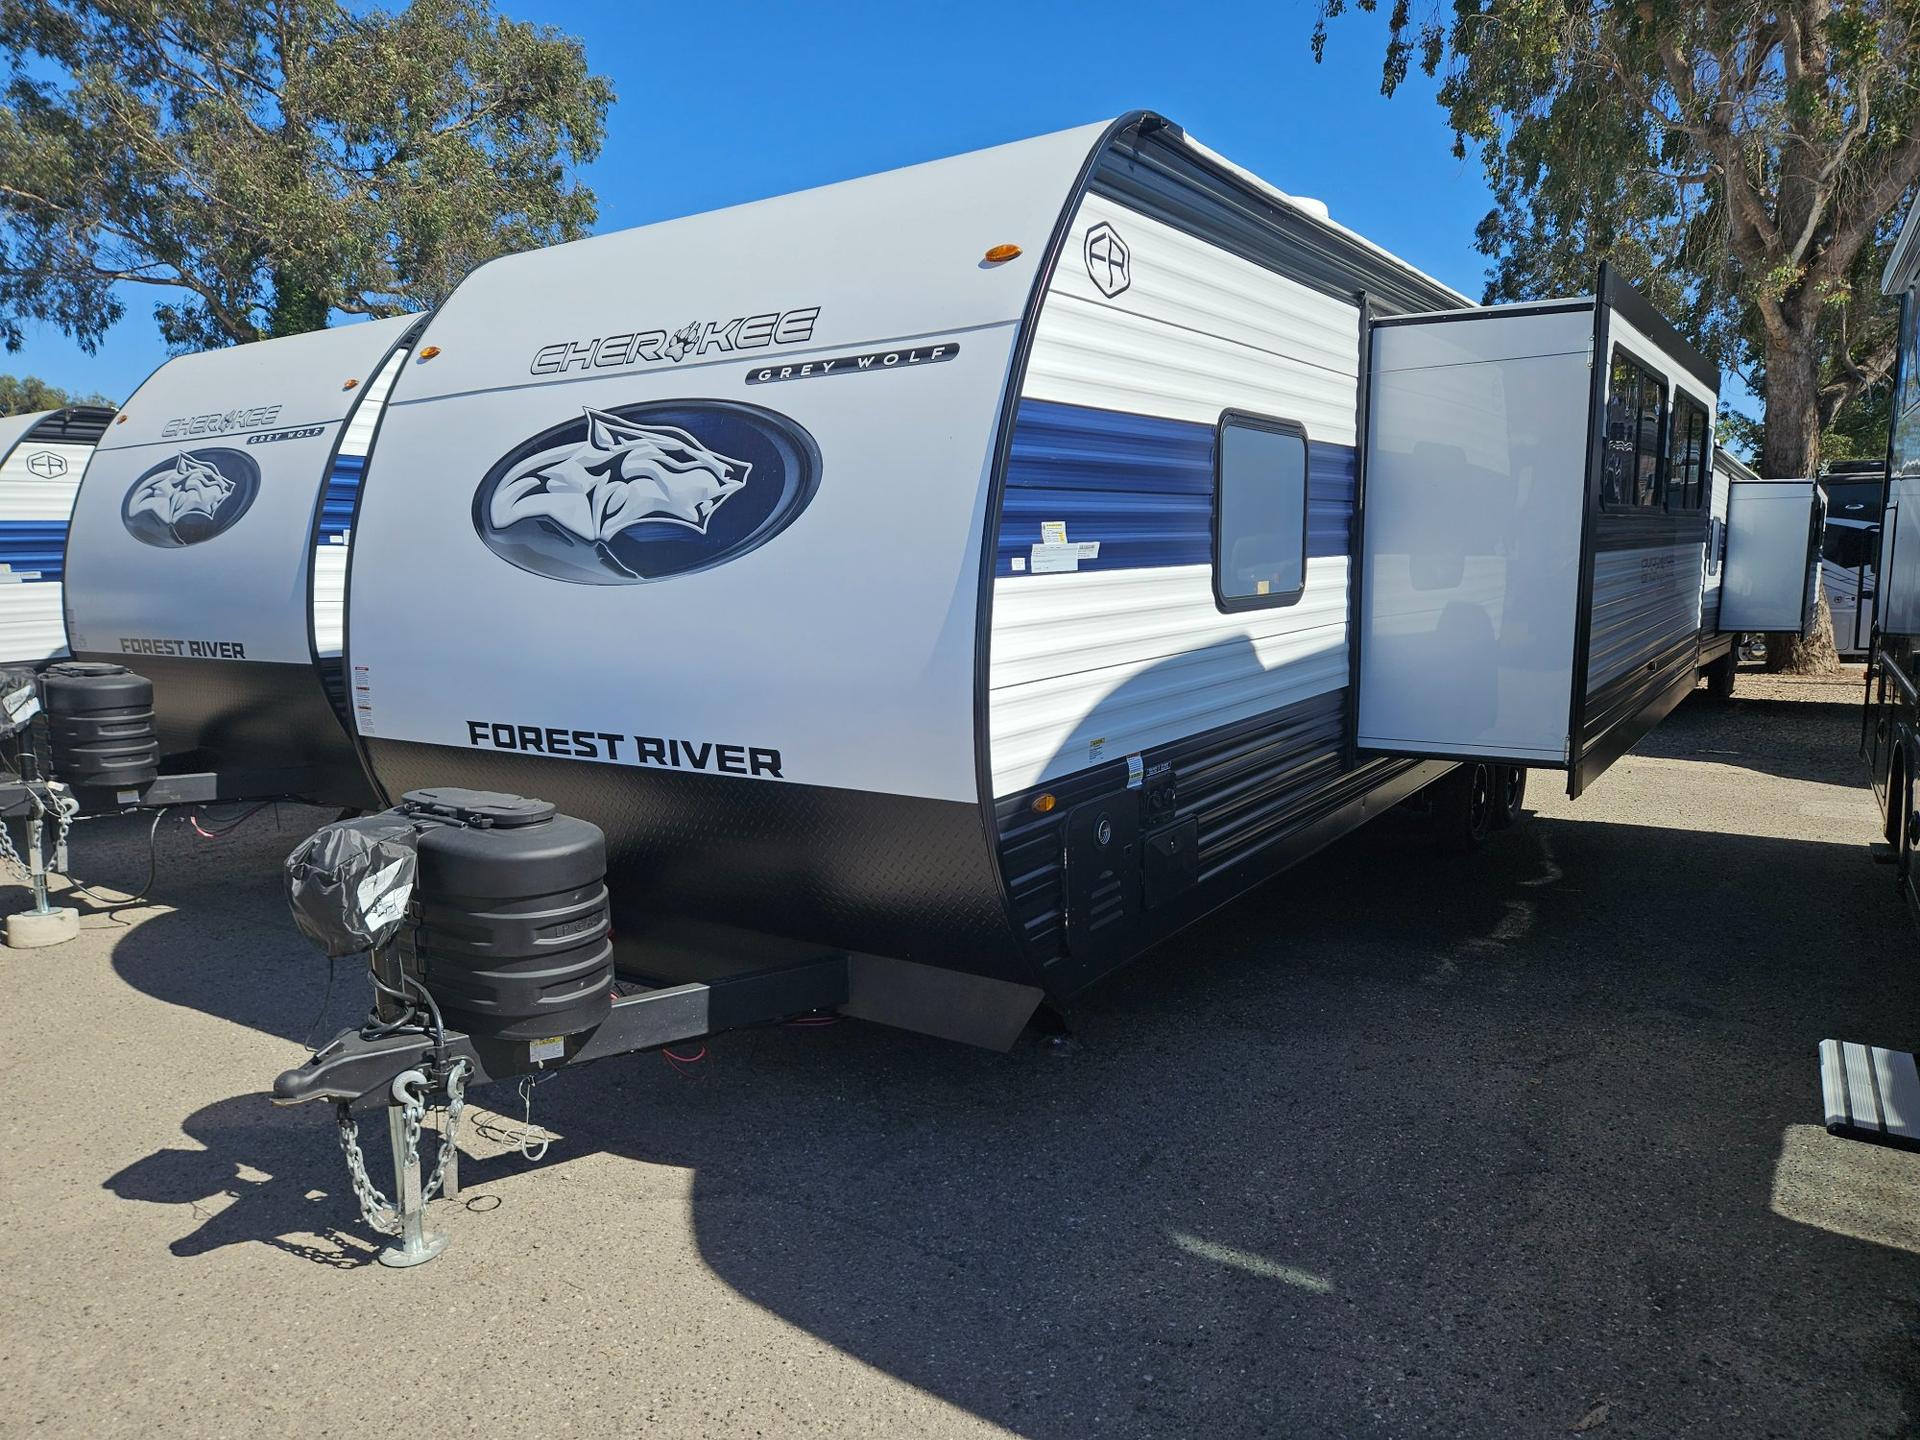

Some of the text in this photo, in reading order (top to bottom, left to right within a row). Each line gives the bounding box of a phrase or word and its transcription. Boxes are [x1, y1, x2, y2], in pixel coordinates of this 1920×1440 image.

[530, 306, 821, 375] CHEROKEE
[757, 346, 949, 382] GREY WOLF
[162, 405, 282, 438] CHEROKEE
[250, 428, 321, 444] GREY WOLF
[119, 638, 246, 660] FOREST RIVER
[466, 720, 784, 778] FOREST RIVER
